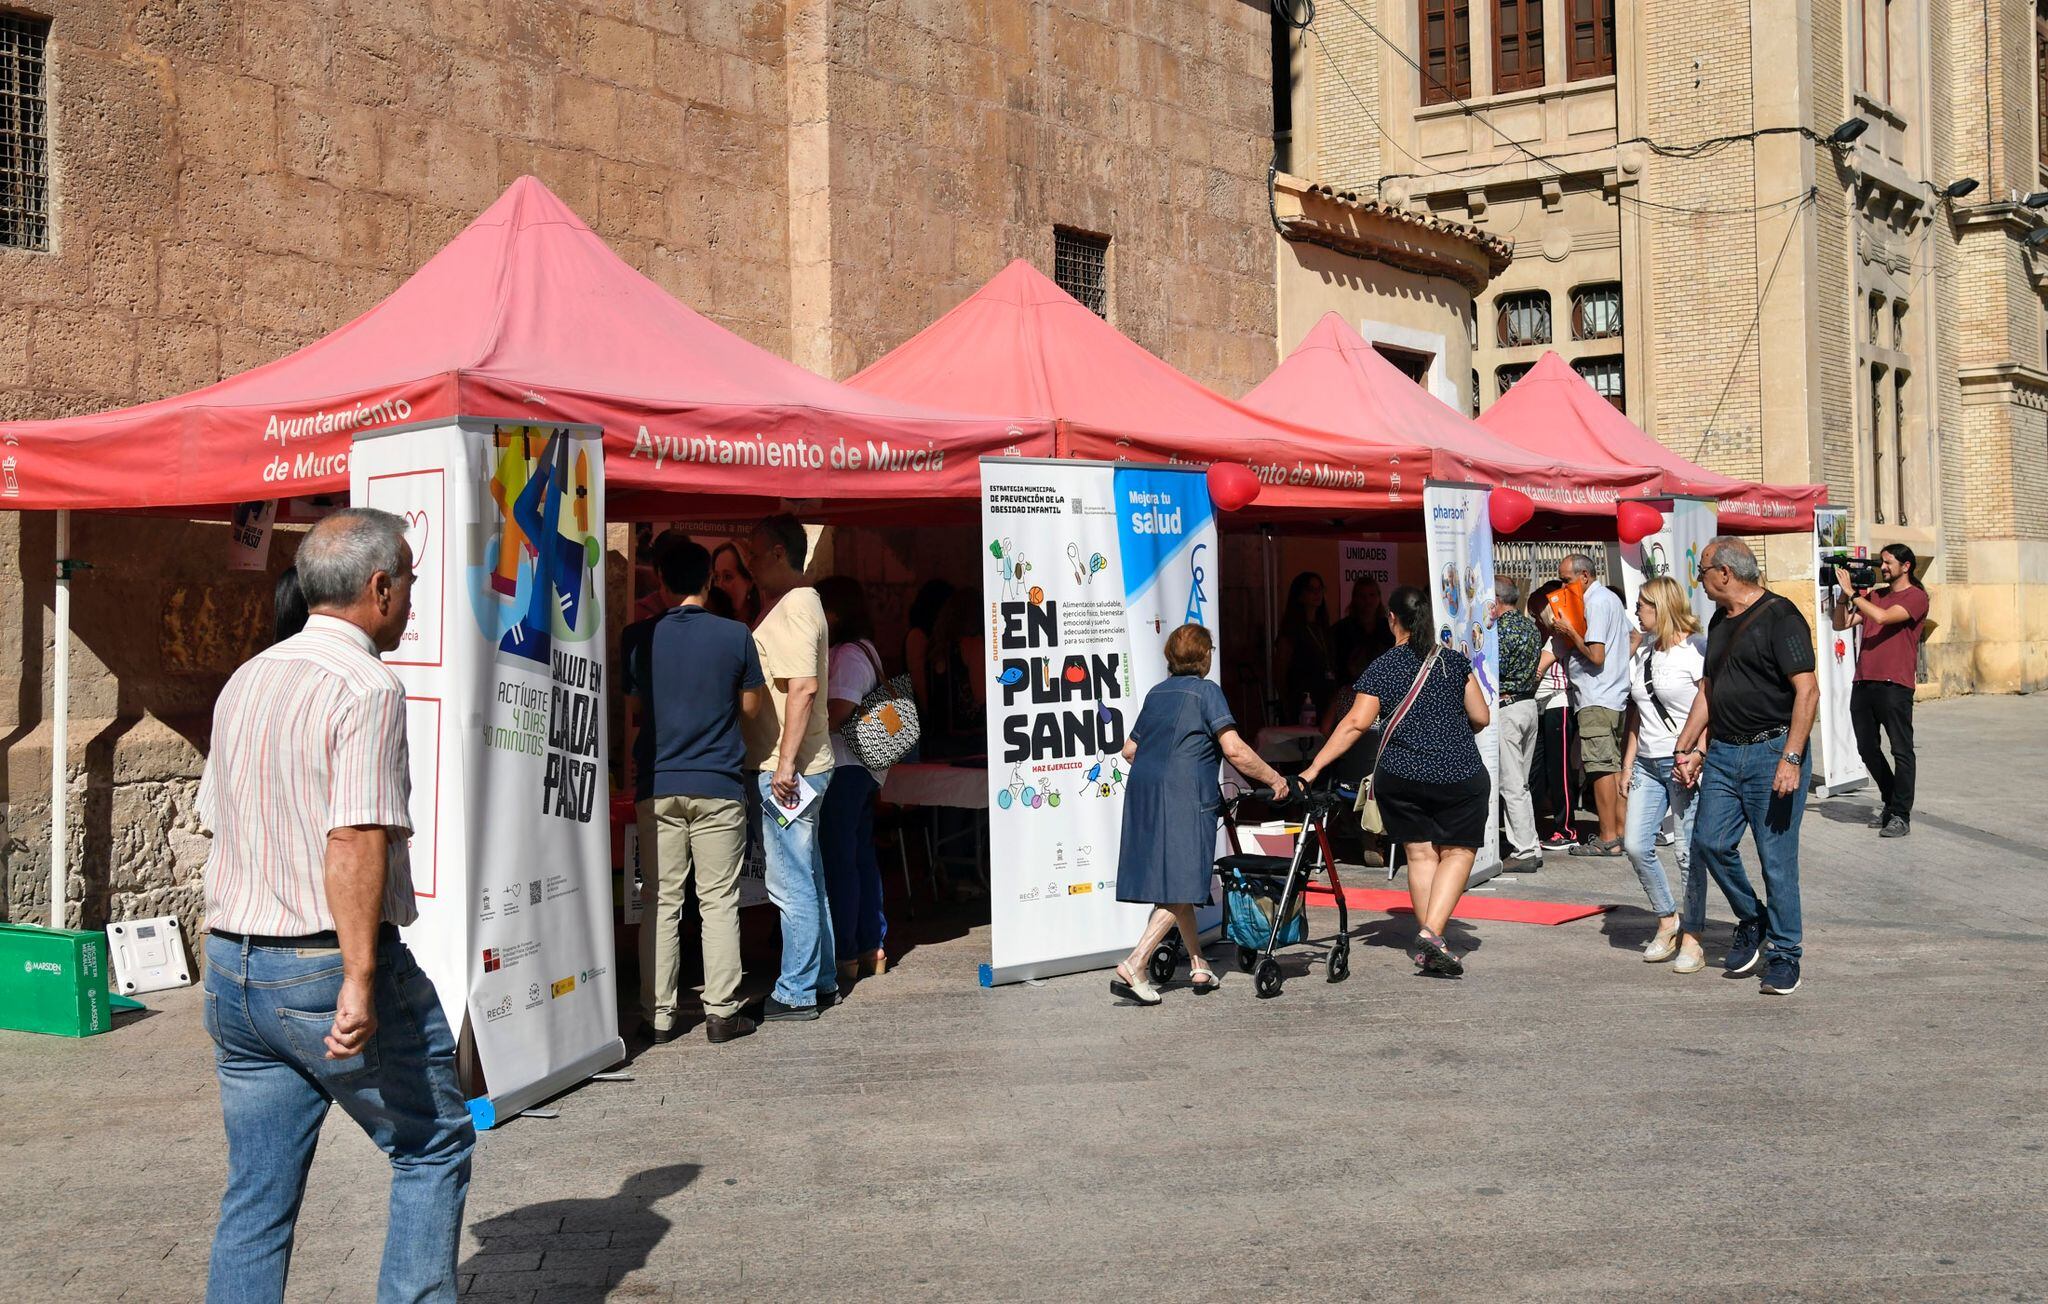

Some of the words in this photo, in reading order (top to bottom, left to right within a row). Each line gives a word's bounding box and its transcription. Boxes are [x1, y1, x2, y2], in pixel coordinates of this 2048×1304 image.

[264, 400, 412, 446] Ayuntamiento
[629, 425, 824, 470] Ayuntamiento
[830, 438, 862, 470] de
[867, 440, 944, 472] Murcia
[262, 456, 289, 482] de
[293, 444, 352, 479] Murci
[1288, 460, 1311, 483] de
[1312, 464, 1366, 488] Murcia
[990, 494, 999, 502] DE
[1000, 494, 1044, 503] PREVENCIÓN
[1128, 490, 1159, 507] Mejora
[1160, 494, 1170, 504] tu
[1573, 488, 1587, 504] de
[1586, 486, 1620, 504] Murcia
[990, 506, 1025, 514] OBESIDAD
[1027, 506, 1061, 514] INFANTIL
[1132, 507, 1182, 535] salud
[1433, 504, 1464, 520] pharaon
[1346, 547, 1386, 560] UNIDADES
[401, 629, 418, 640] urcia
[1002, 600, 1058, 649] EN
[552, 648, 588, 688] SALUD
[590, 660, 602, 693] EN
[1002, 653, 1121, 706] PLAN
[498, 681, 549, 712] ACTÍVATE
[512, 708, 520, 729] 4
[549, 685, 599, 758] CADA
[482, 725, 492, 747] 40
[494, 728, 544, 757] MINUTOS
[1003, 708, 1125, 763] SANO
[1032, 764, 1046, 773] HAZ
[1047, 762, 1082, 772] EJERCICIO
[543, 752, 596, 823] PASO
[751, 864, 765, 880] PAS
[33, 962, 62, 971] MARSDEN
[487, 1005, 506, 1019] RECS
